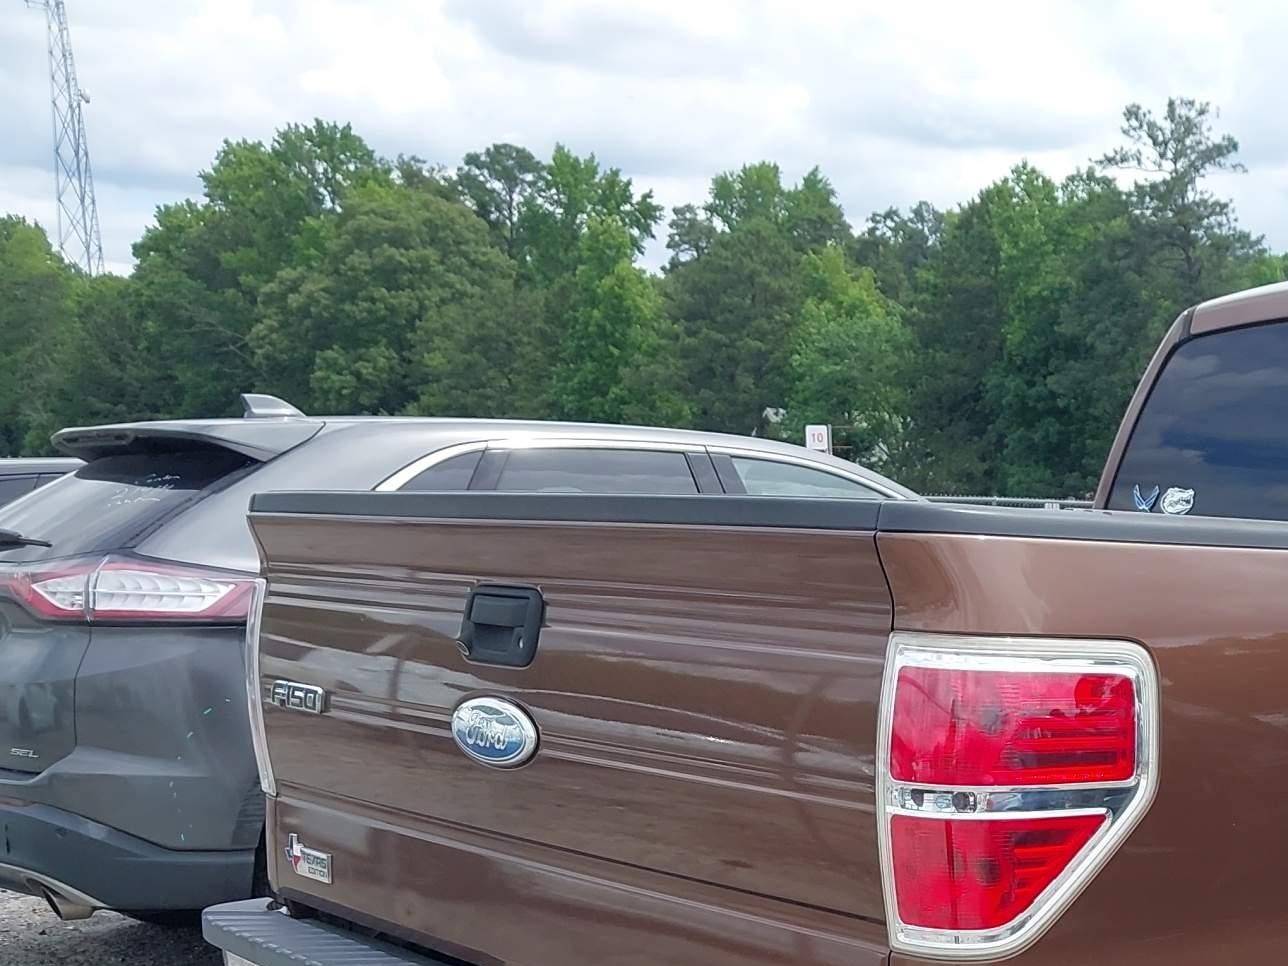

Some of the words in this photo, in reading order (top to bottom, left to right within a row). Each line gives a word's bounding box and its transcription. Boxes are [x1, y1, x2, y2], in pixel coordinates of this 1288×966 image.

[811, 432, 824, 443] 10
[465, 711, 508, 750] Ford
[10, 748, 39, 758] SEL
[303, 853, 328, 870] TEXAS
